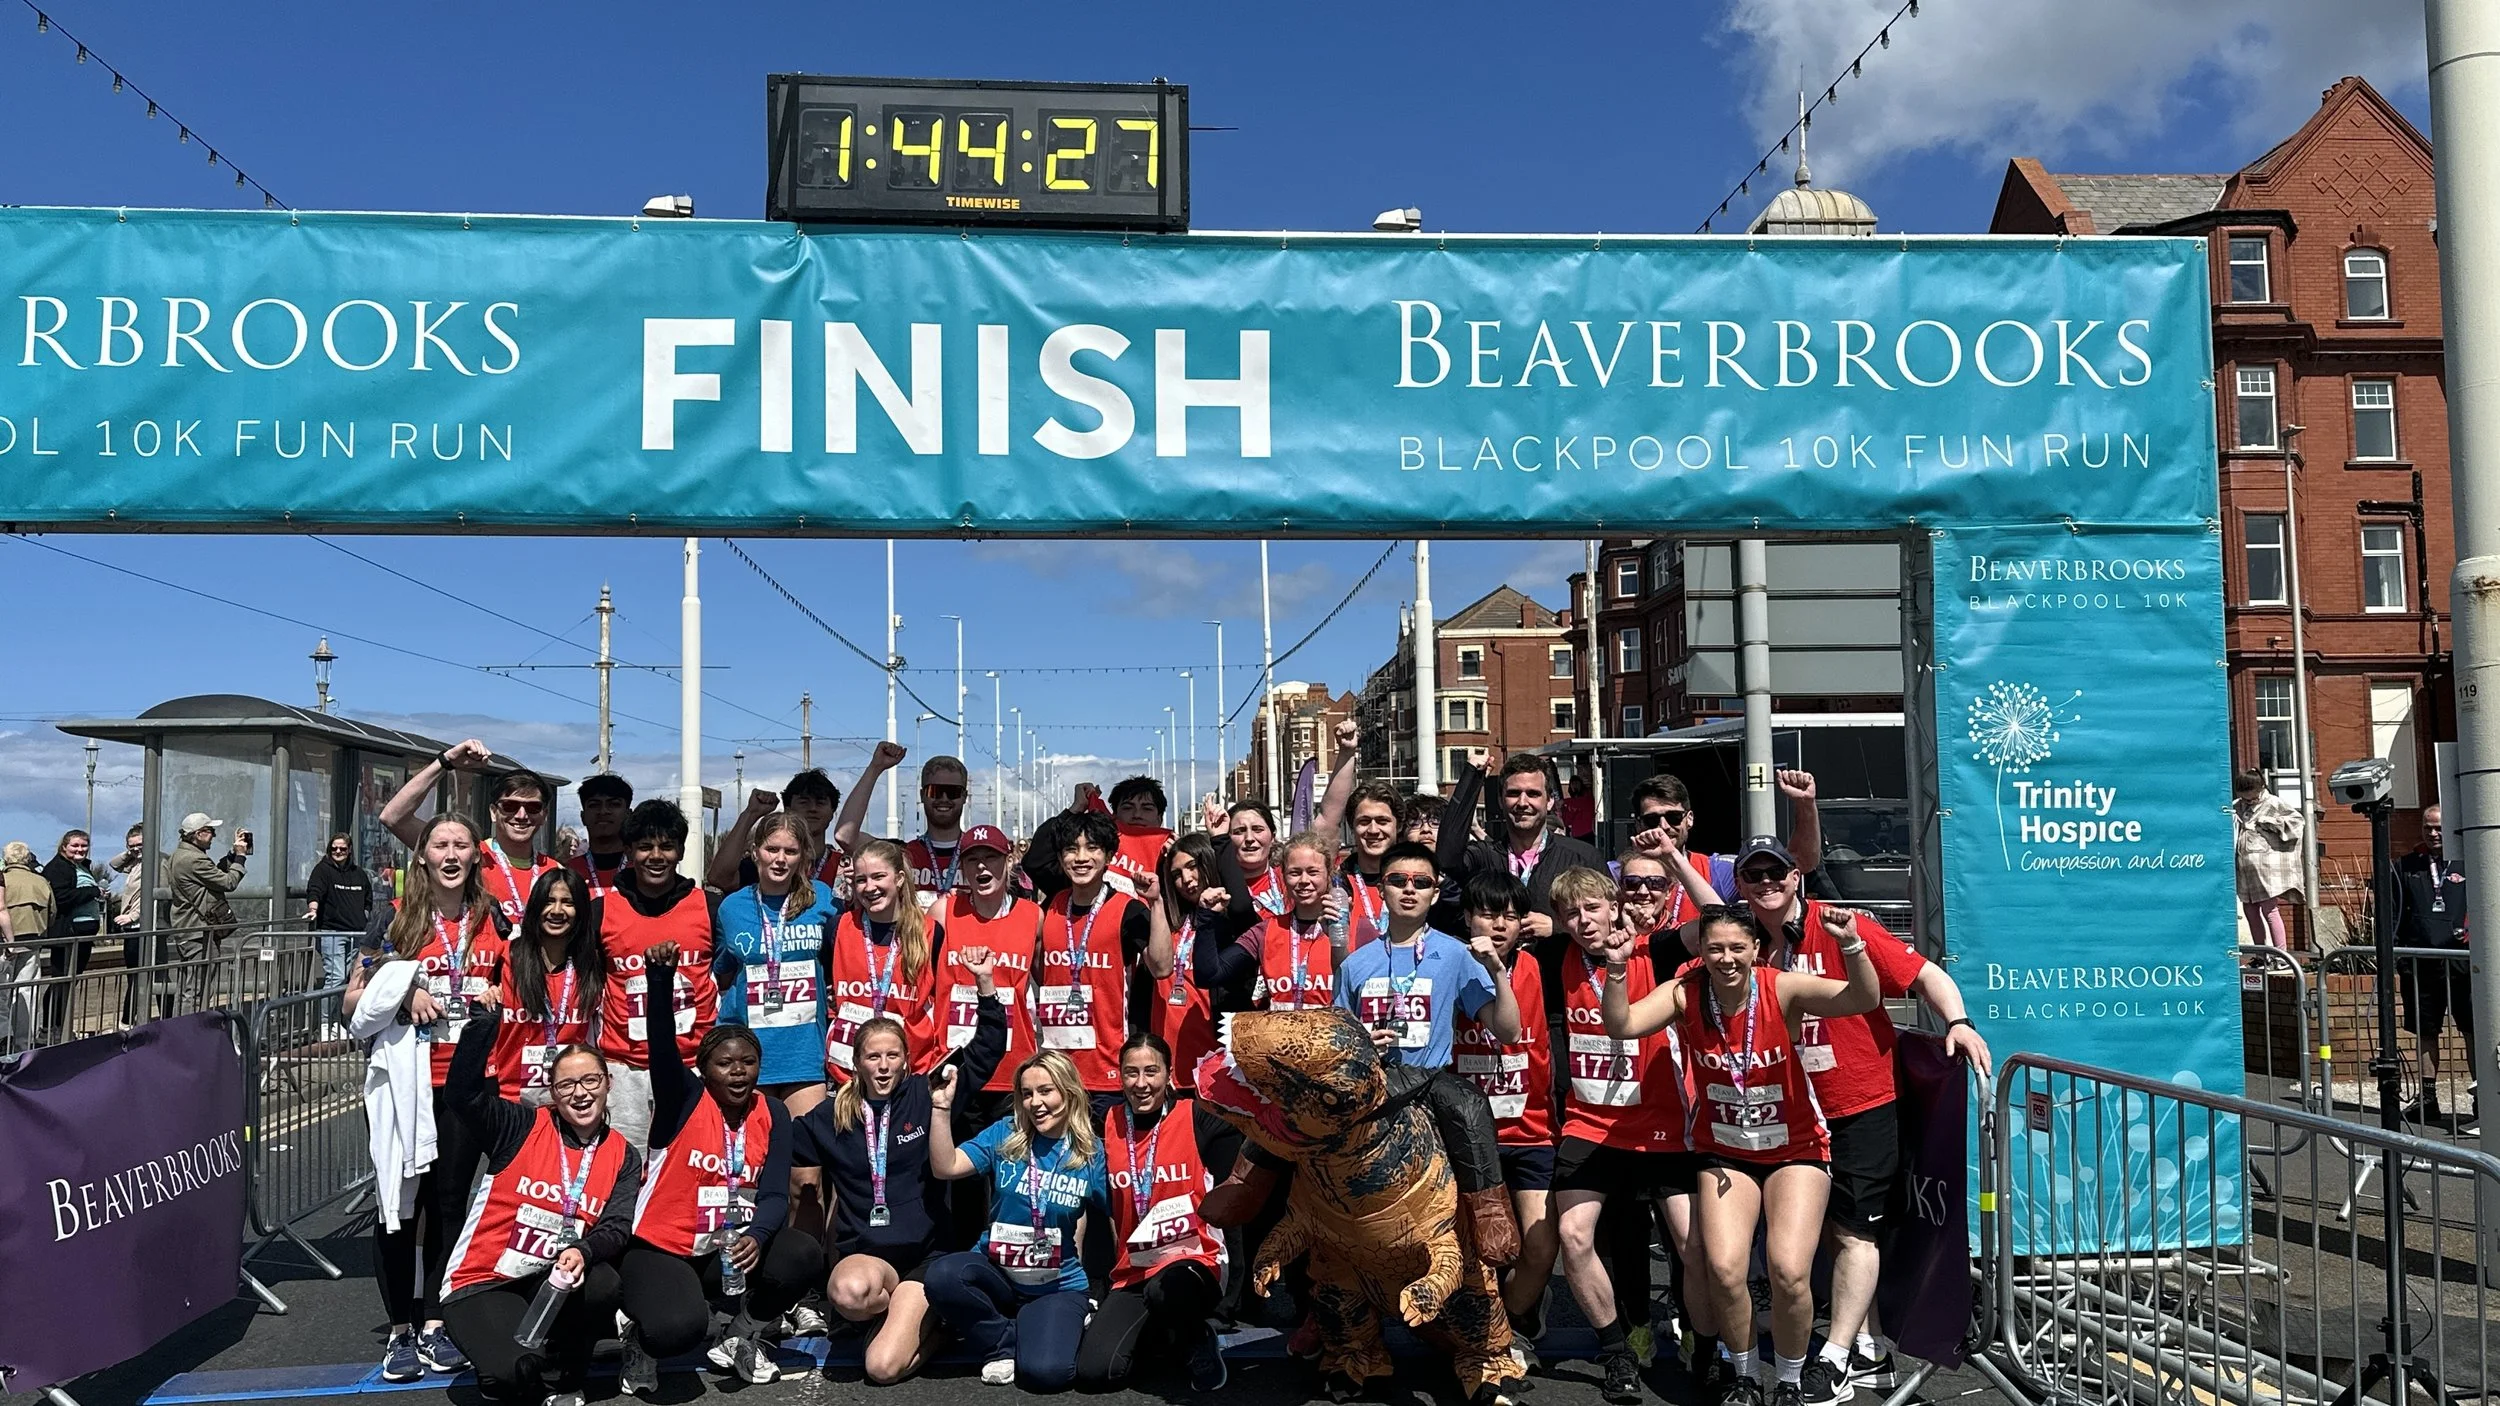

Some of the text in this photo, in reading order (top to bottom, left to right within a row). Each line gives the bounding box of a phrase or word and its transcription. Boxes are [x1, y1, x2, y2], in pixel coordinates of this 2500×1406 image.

[838, 113, 1159, 191] 1:44:27
[945, 196, 1020, 210] TIMEWISE
[18, 295, 521, 376] RBROOKS
[1391, 299, 2154, 391] BEAVERBROOKS
[641, 317, 1272, 460] FINISH
[96, 419, 203, 457] 10K
[235, 420, 355, 459] FUN
[389, 423, 514, 462] RUN
[1400, 432, 2150, 472] BLACKPOOL 10K FUN RUN
[1968, 555, 2186, 583] BEAVERBROOKS
[1969, 592, 2188, 610] BLACKPOOL 10K
[2459, 684, 2477, 699] 119
[2012, 779, 2117, 816] Trinity
[2020, 815, 2142, 849] Hospice
[2020, 848, 2206, 877] Compassion and care
[1044, 950, 1113, 969] ROSALL
[754, 979, 811, 1003] 172
[837, 980, 919, 1002] ROSALL
[1985, 962, 2203, 991] BEAVERBROOKS
[955, 1003, 979, 1026] 17
[1987, 1000, 2206, 1019] BLACKPOOL 10K
[896, 1126, 925, 1145] Rossall
[1653, 1131, 1667, 1141] 22
[45, 1129, 243, 1242] BEAVERBROOKS
[514, 1226, 560, 1260] 176
